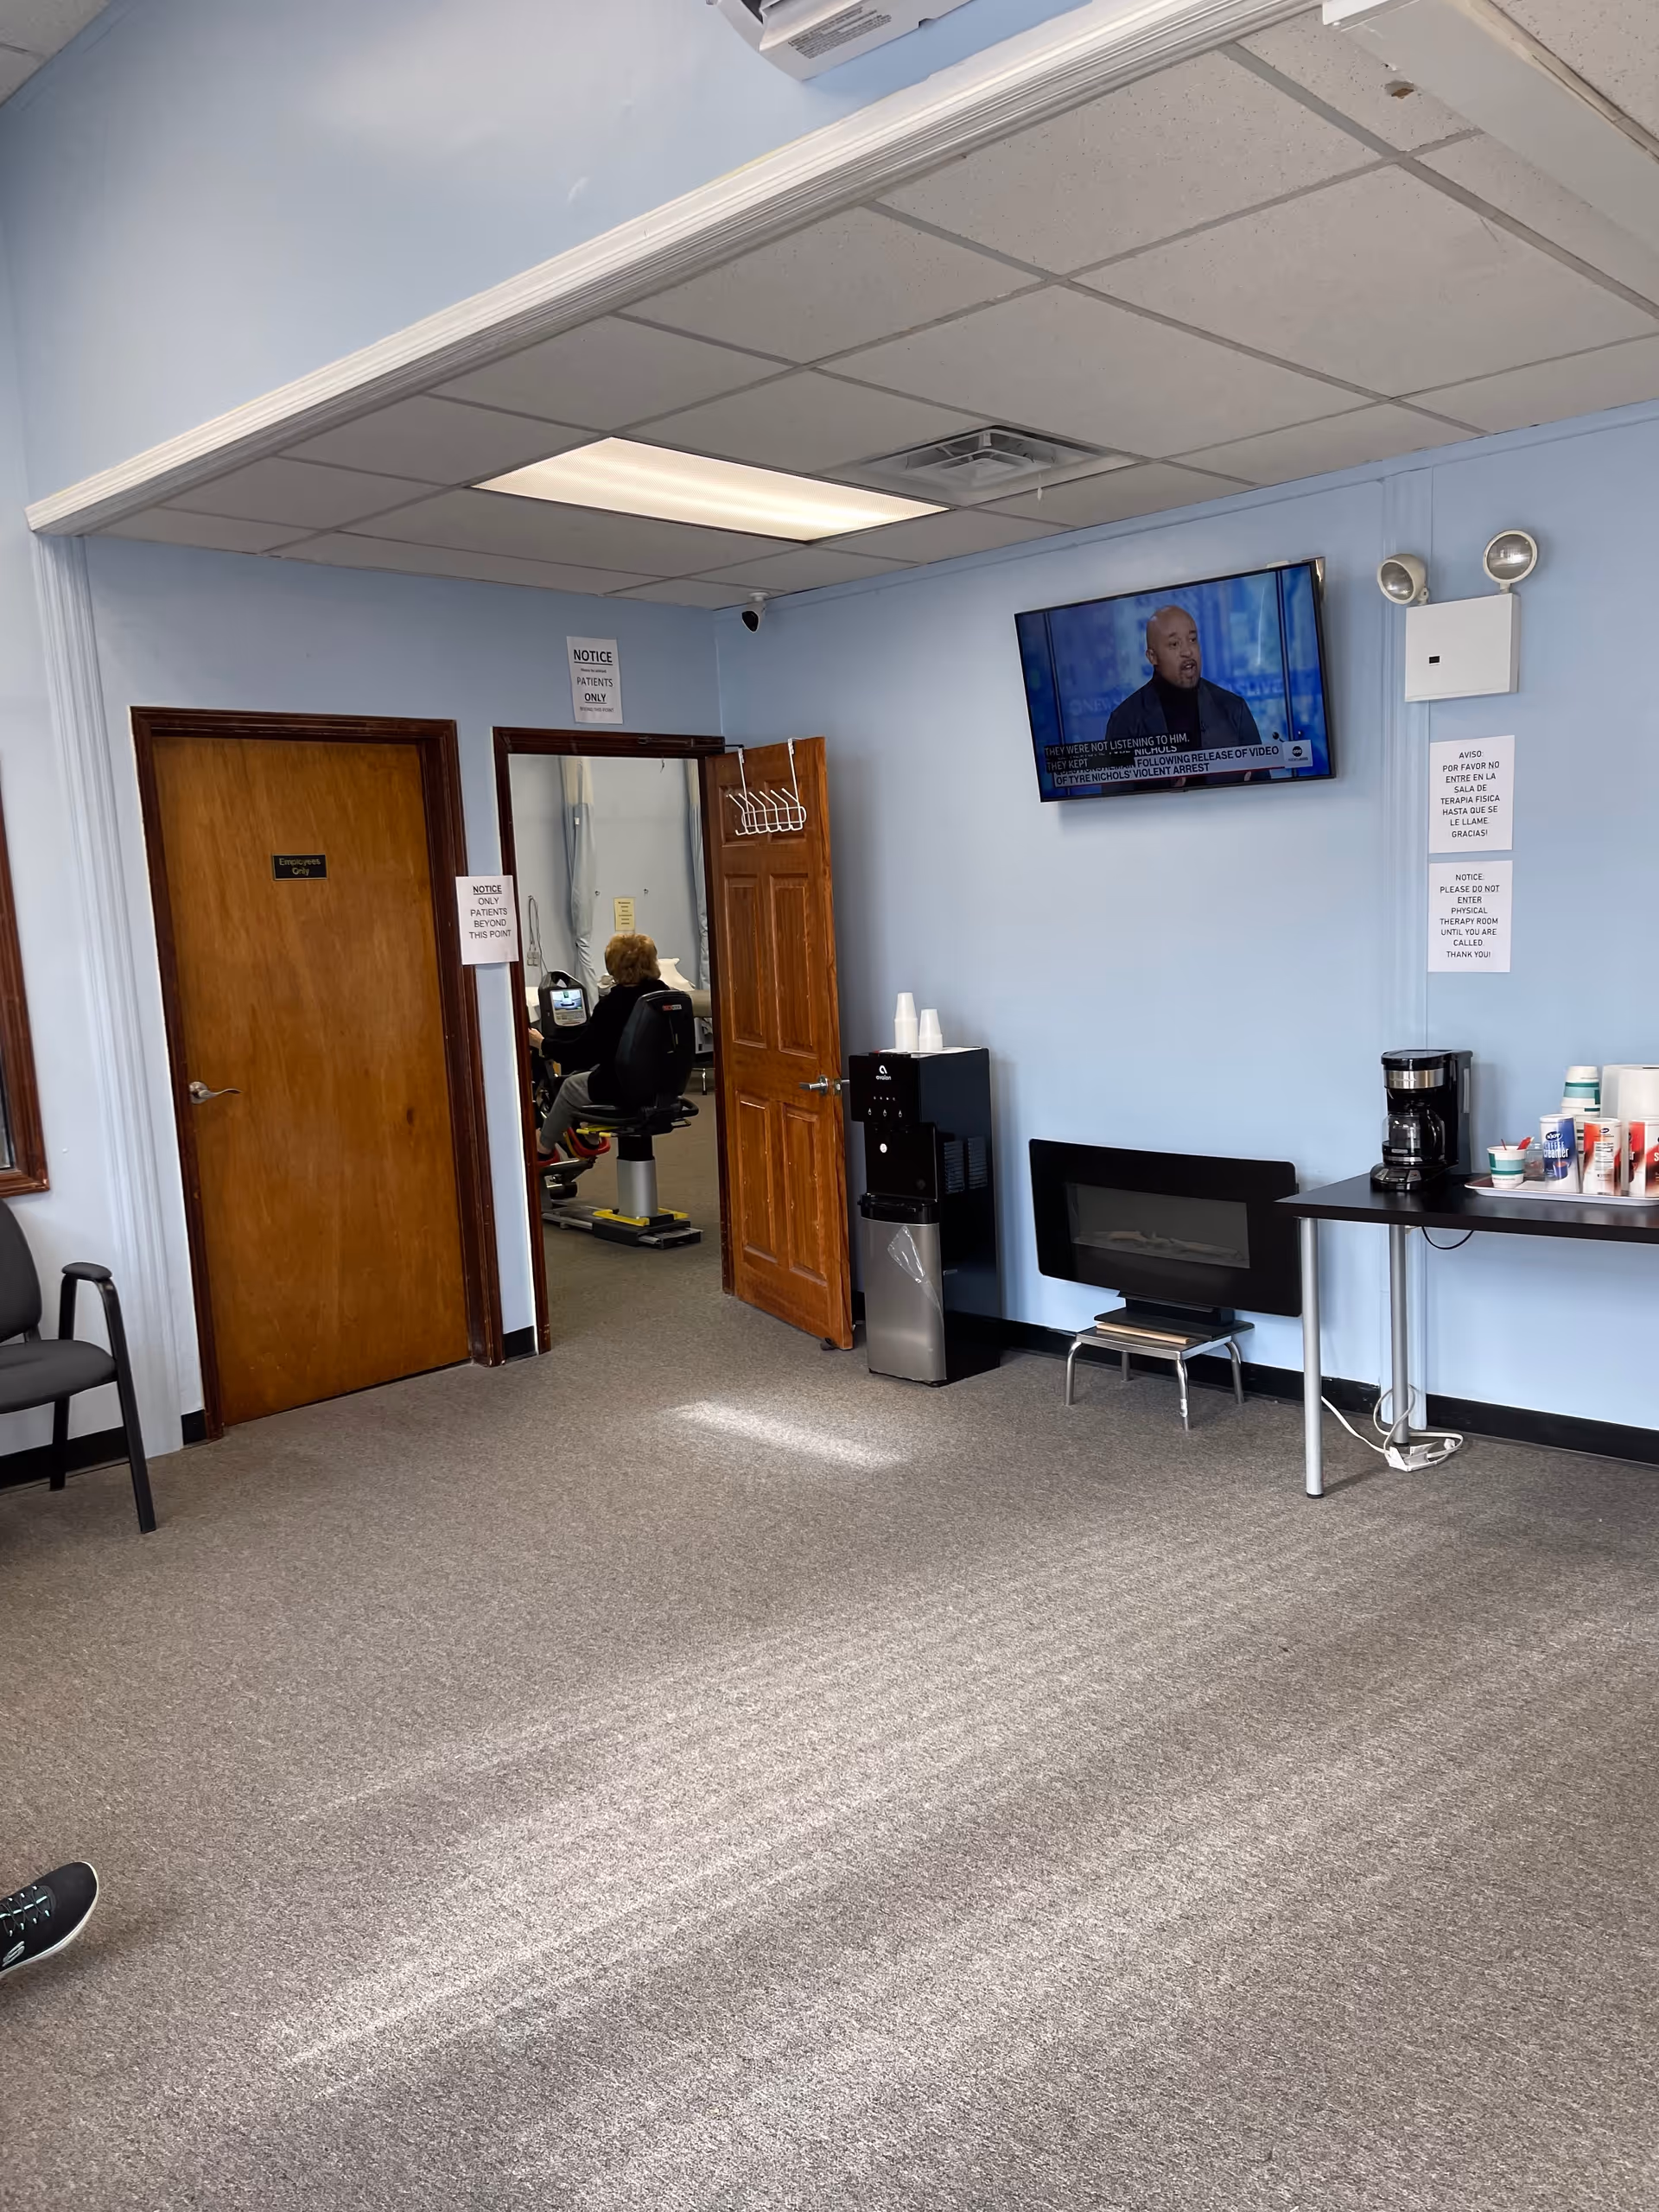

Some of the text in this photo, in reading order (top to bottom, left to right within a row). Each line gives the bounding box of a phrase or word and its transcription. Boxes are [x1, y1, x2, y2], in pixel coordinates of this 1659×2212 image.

[574, 649, 613, 663] NOTICE
[577, 677, 613, 687] PATIENTS
[585, 693, 607, 702] ONLY
[1045, 747, 1065, 756] THEY
[1066, 744, 1090, 754] WERE
[1090, 741, 1108, 752] NOT
[1109, 736, 1154, 750] LISTENING
[1155, 734, 1167, 745] TO
[1169, 733, 1190, 744] HIM.
[1137, 754, 1191, 767] FOLLOWING
[1192, 751, 1234, 763] RELEASE
[1234, 749, 1246, 759] OF
[1249, 746, 1279, 756] VIDEO
[1046, 760, 1067, 771] THEY
[1068, 759, 1088, 769] KEPT
[1460, 762, 1486, 771] FAVOR
[1488, 760, 1500, 769] NO
[1056, 776, 1068, 785] OF
[1068, 774, 1091, 784] TYRE
[1091, 769, 1132, 782] NICHOLS'
[1133, 766, 1171, 778] VIOLENT
[1173, 763, 1210, 774] ARREST
[1446, 774, 1471, 783] ENTRE
[1452, 829, 1488, 838] GRACIAS!
[291, 867, 310, 876] Only
[470, 907, 508, 917] PATIENTS
[474, 918, 506, 927] BEYOND
[469, 931, 487, 939] THIS
